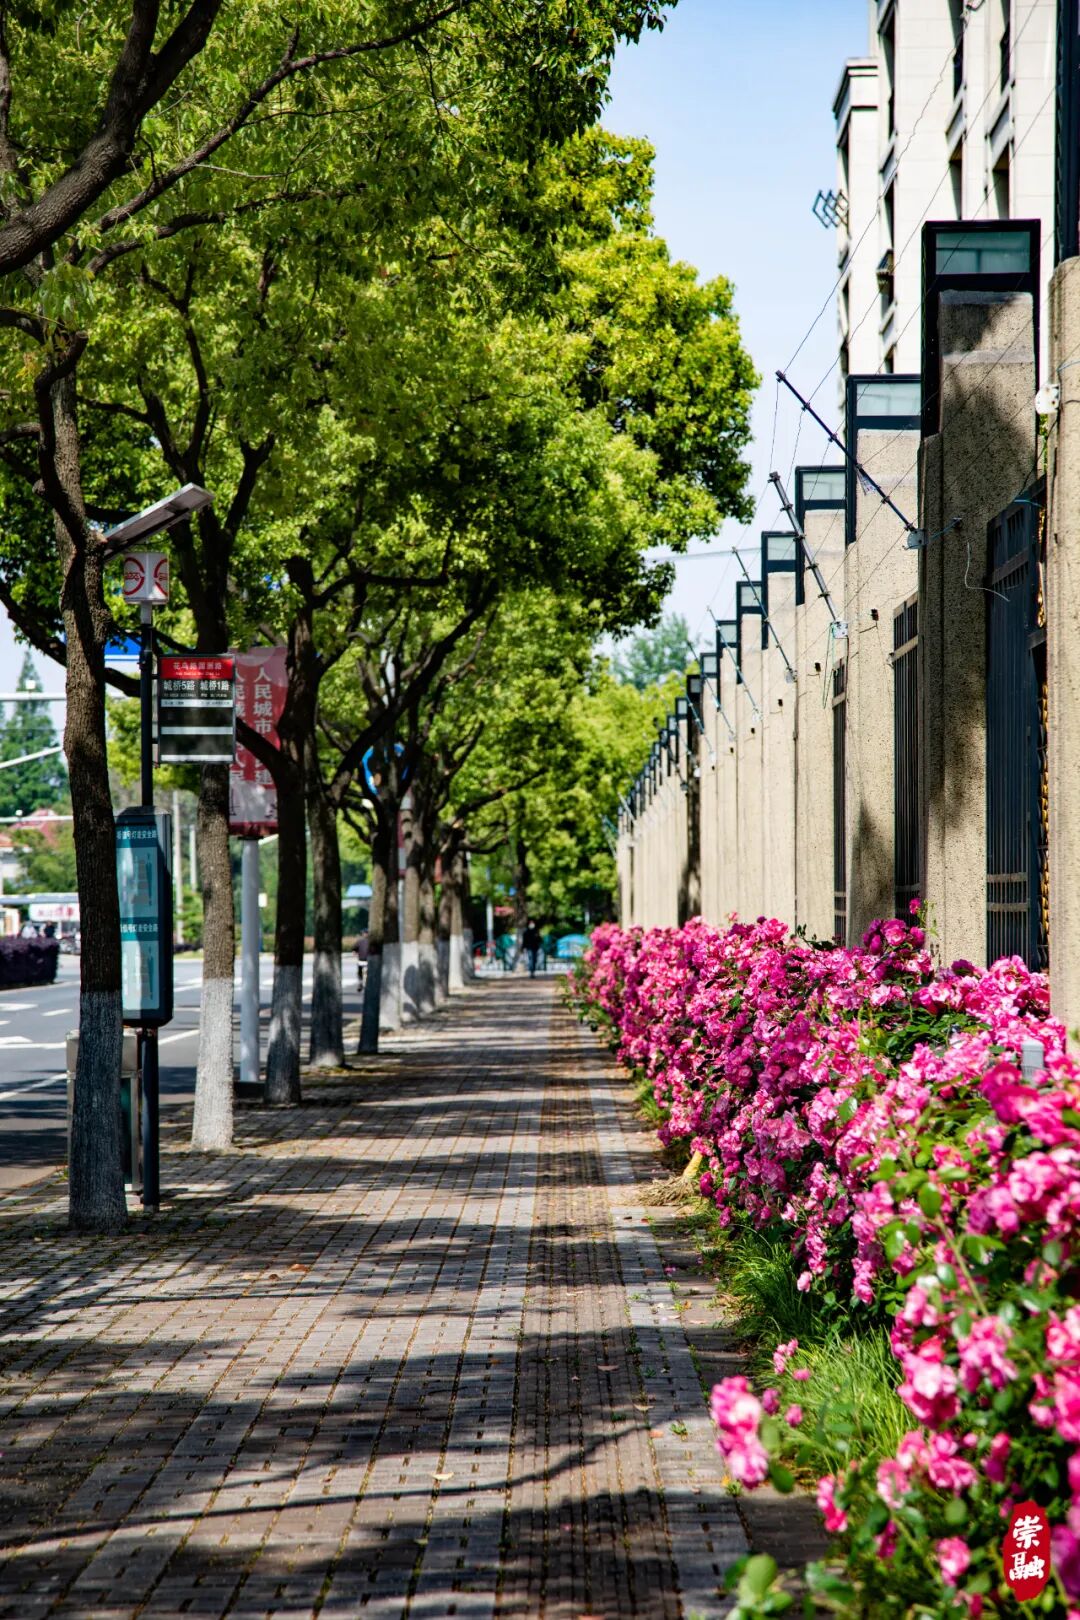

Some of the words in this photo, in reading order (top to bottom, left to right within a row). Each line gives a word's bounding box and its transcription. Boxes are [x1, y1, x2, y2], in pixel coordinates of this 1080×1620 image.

[163, 680, 195, 691] 城桥5路
[200, 680, 229, 691] 城桥1路
[253, 667, 273, 785] 人民城市建
